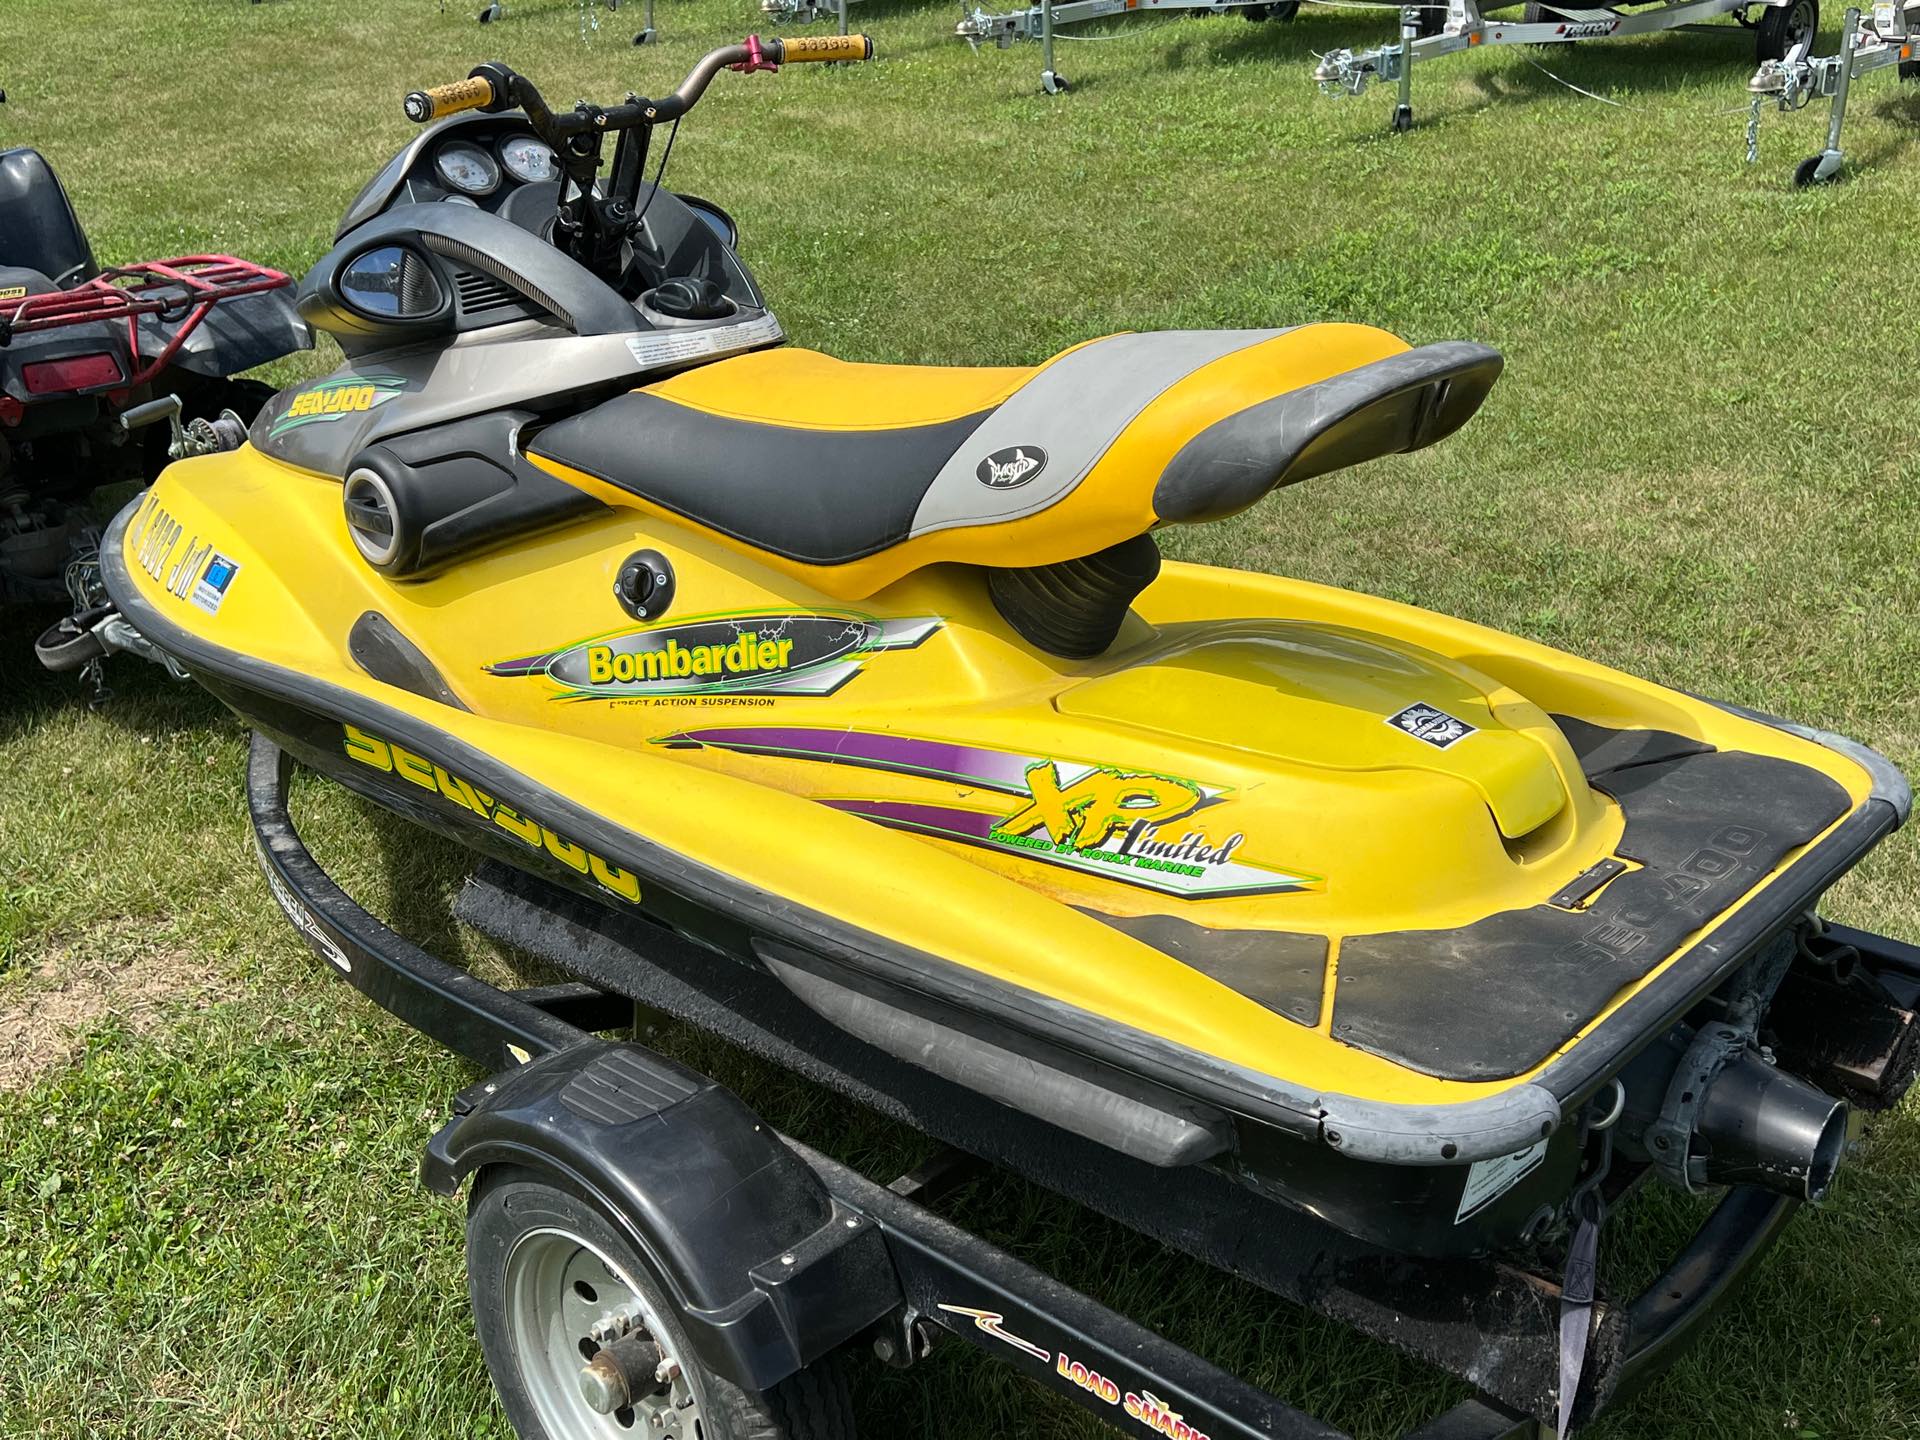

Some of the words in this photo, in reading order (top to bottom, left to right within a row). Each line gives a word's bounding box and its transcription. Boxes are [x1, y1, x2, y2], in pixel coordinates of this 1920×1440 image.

[1565, 21, 1615, 35] TRITON
[588, 631, 793, 684] Bombardier
[653, 698, 697, 707] ACTION
[701, 697, 775, 707] SUSPENSION
[991, 758, 1204, 850] XP
[989, 831, 1053, 850] POWERED
[1055, 844, 1081, 856] BY
[1080, 848, 1135, 868] ROTAX
[1134, 856, 1207, 878] MARINE
[1056, 1352, 1121, 1406] LOAD
